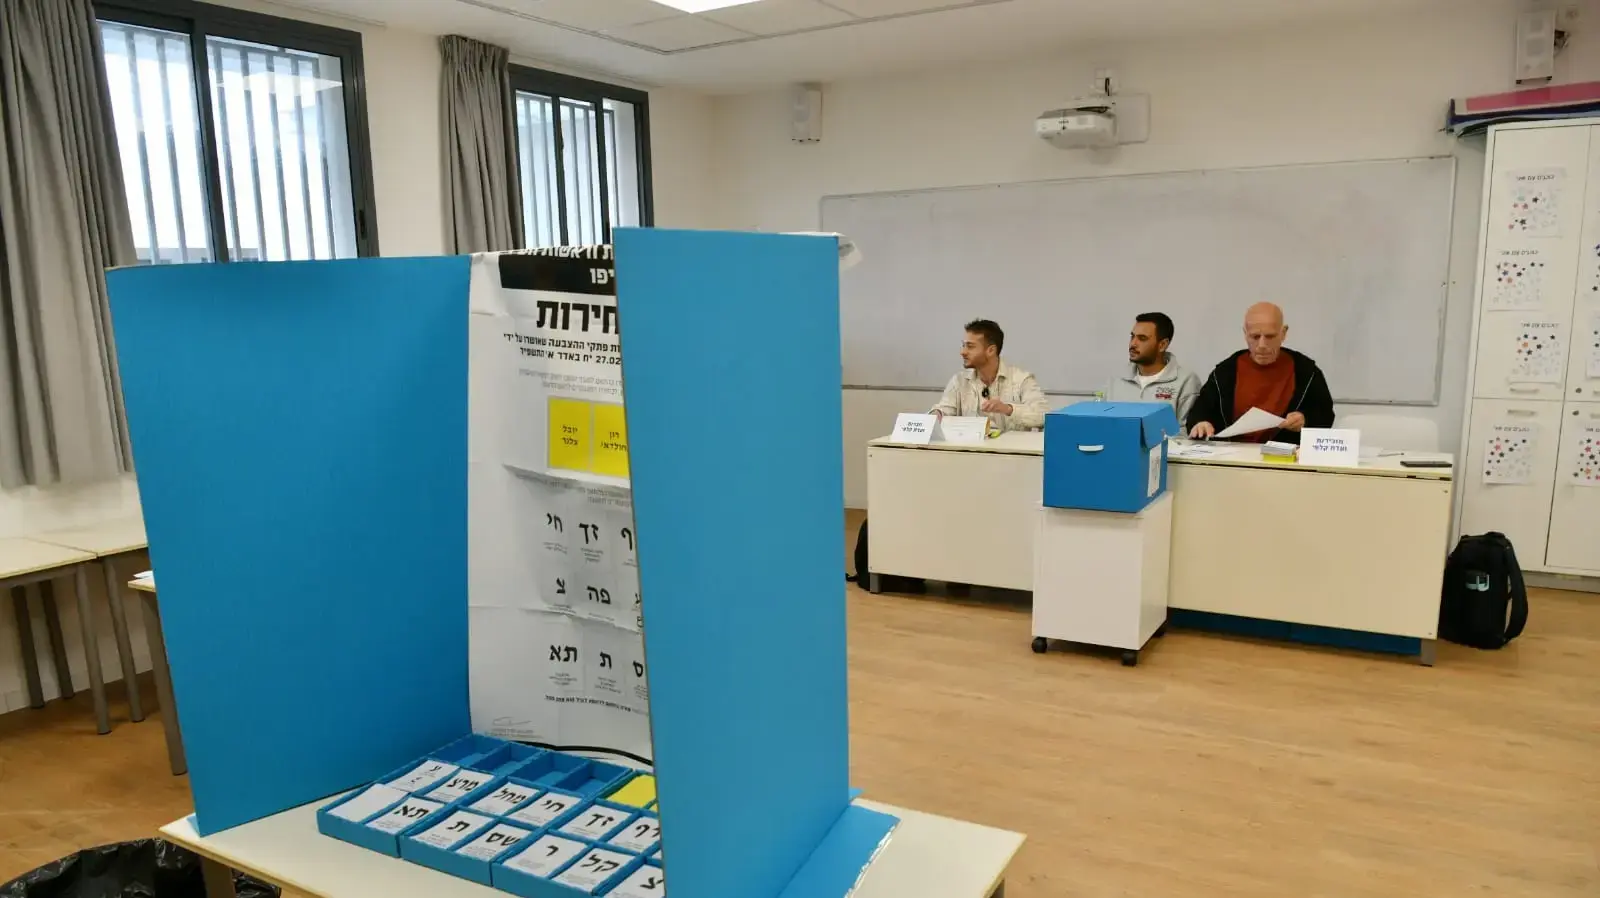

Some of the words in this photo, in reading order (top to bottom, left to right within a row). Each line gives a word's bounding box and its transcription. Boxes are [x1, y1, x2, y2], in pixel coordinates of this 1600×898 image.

[503, 333, 514, 342] ידי
[515, 332, 523, 342] על
[524, 335, 546, 345] שאושרו
[548, 338, 585, 350] ההצבעה
[587, 342, 608, 351] פתקי
[557, 352, 581, 361] באדר
[609, 431, 620, 440] רון
[1312, 444, 1329, 452] קלפי
[547, 512, 563, 533] חי
[578, 522, 599, 544] זך
[556, 577, 566, 594] צ
[587, 585, 611, 604] פה
[549, 644, 578, 662] תא
[599, 651, 612, 669] ת
[447, 777, 478, 792] מרצ
[492, 788, 527, 804] מחל
[392, 805, 429, 818] תא
[540, 800, 565, 812] חי
[585, 813, 614, 827] זך
[447, 821, 470, 832] ת
[547, 845, 559, 856] ר
[581, 854, 620, 873] קל
